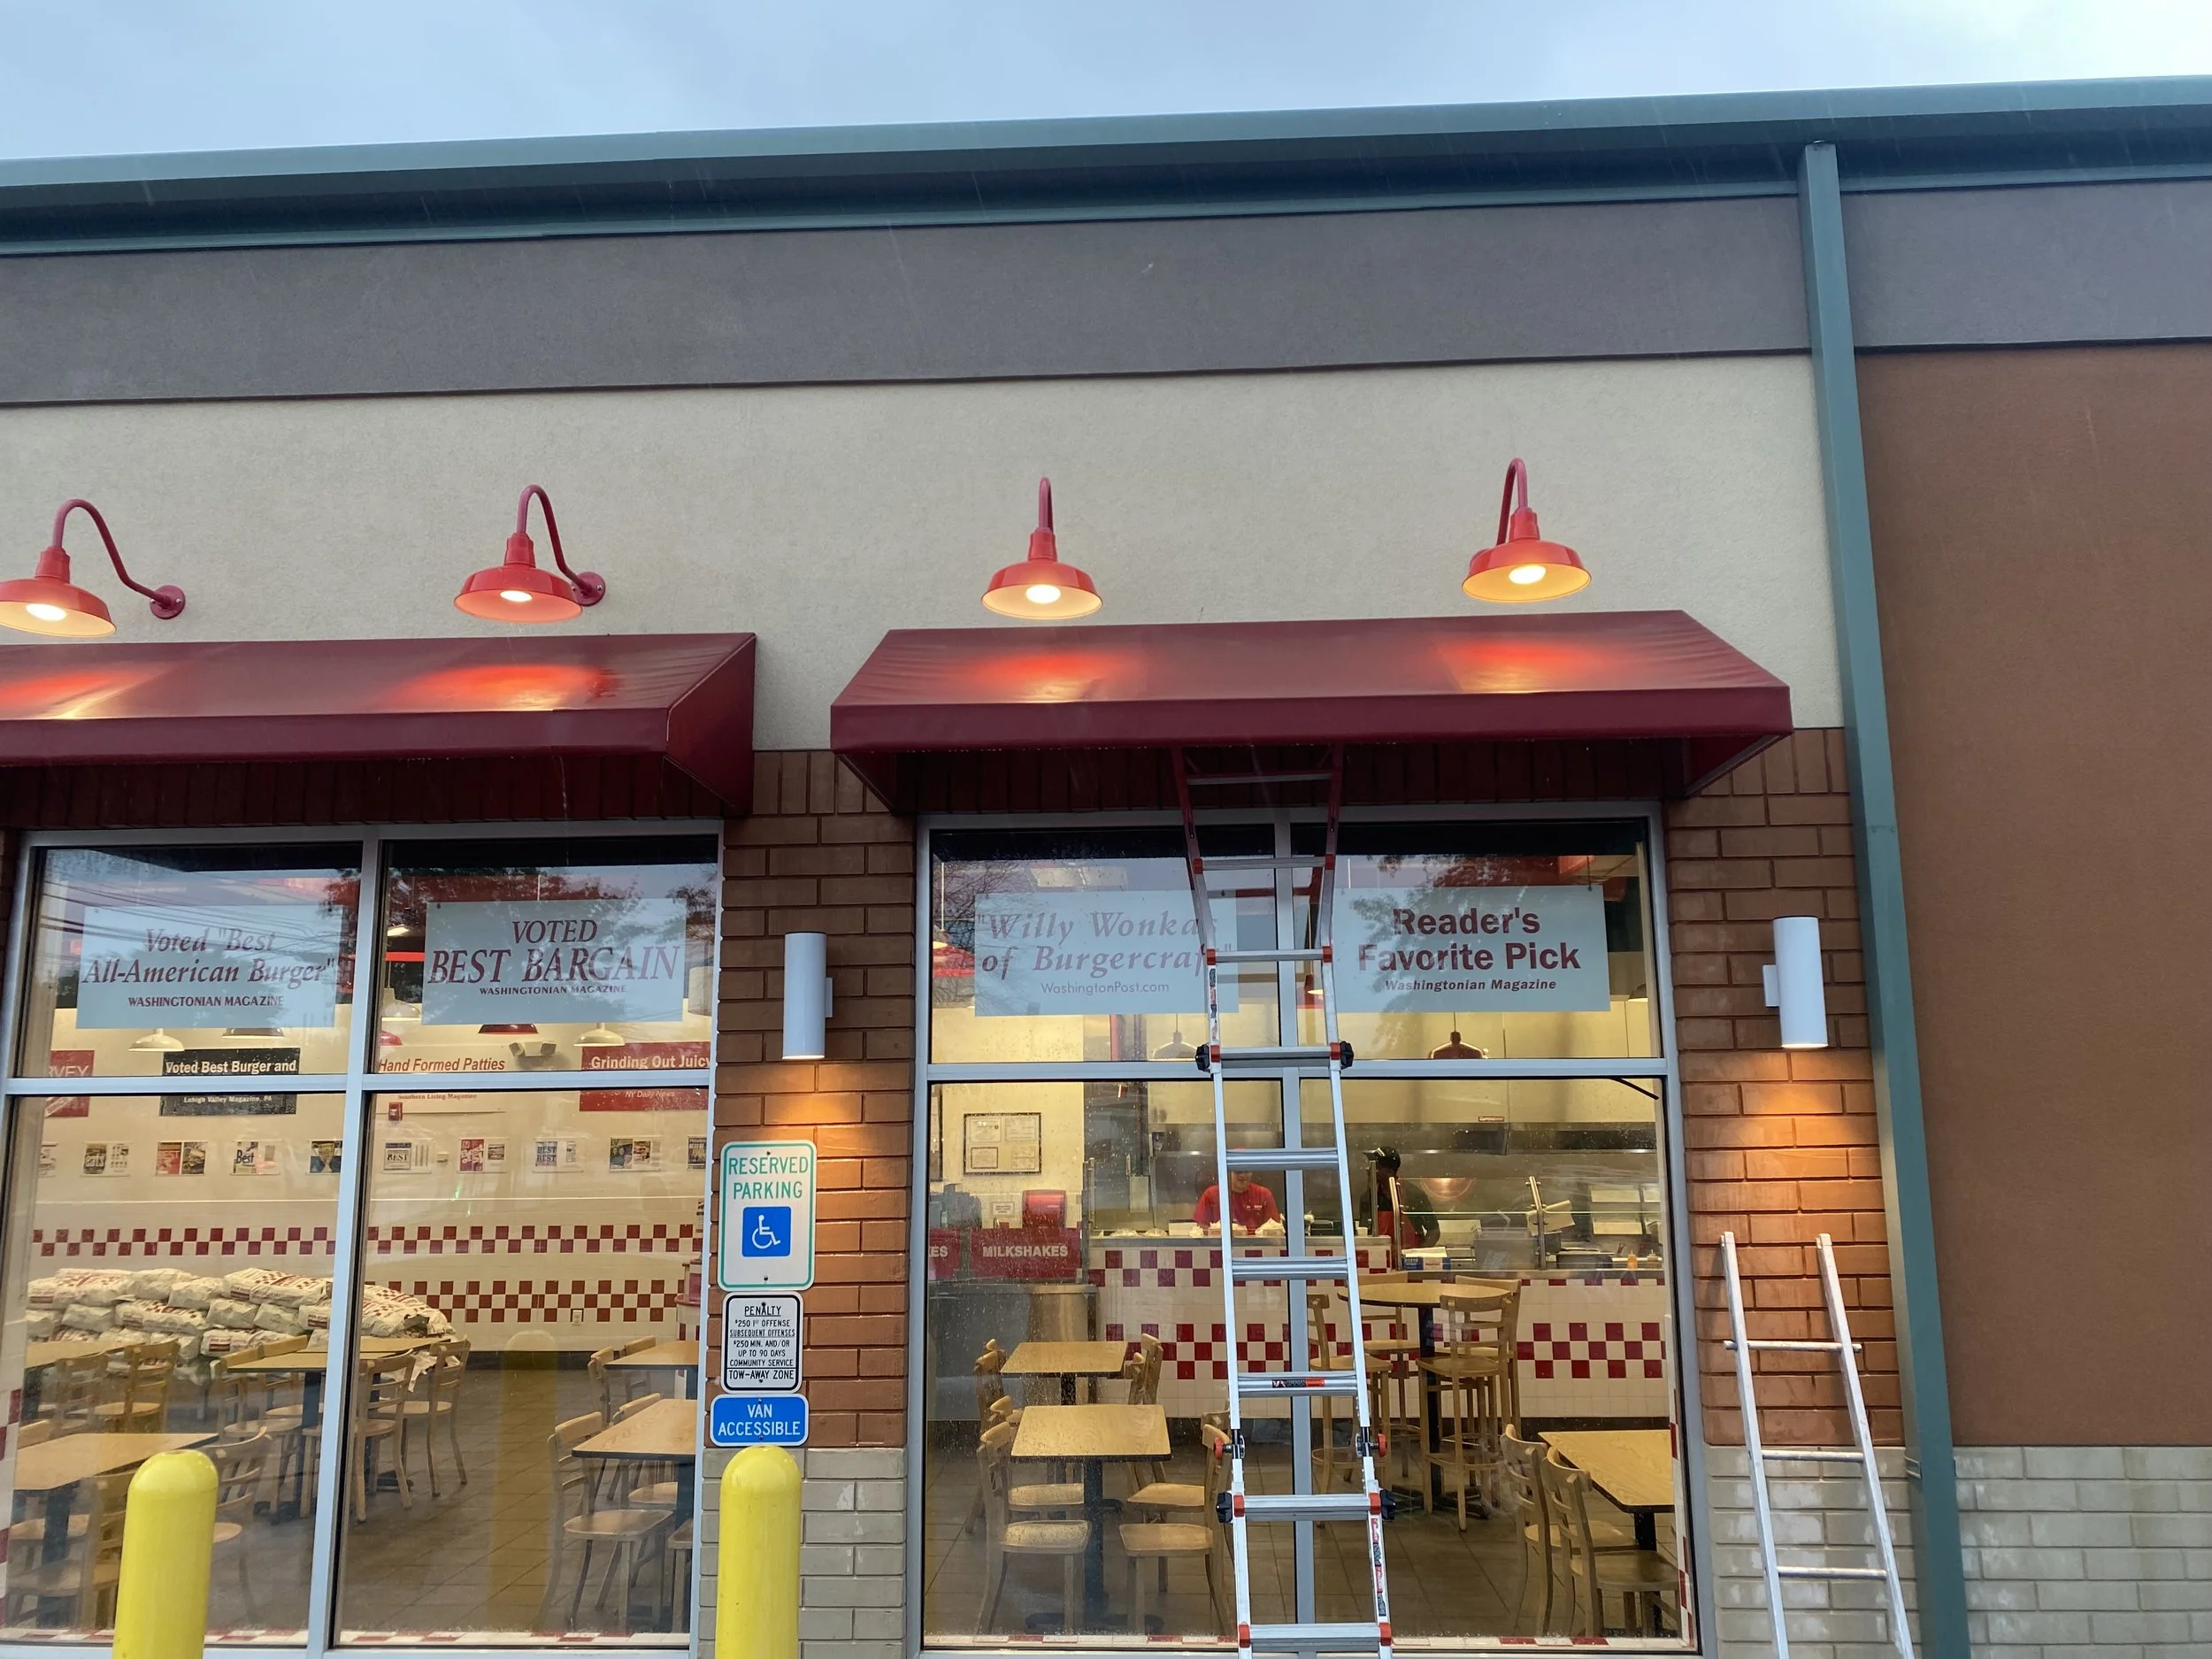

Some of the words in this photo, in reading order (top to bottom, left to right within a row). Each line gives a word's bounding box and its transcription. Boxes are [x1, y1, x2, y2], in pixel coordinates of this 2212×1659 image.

[978, 911, 1074, 945] "Willy
[1089, 910, 1217, 938] Wonka
[1393, 907, 1540, 935] Reader's
[511, 919, 598, 944] VOTED
[146, 928, 209, 953] Voted
[218, 927, 276, 952] "Best
[981, 946, 1018, 980] of
[1033, 944, 1233, 979] Burgercraf"
[1358, 942, 1494, 972] Favorite
[1505, 941, 1582, 970] Pick
[428, 949, 511, 984] BEST
[522, 945, 681, 982] BARGAIN
[82, 958, 240, 984] All-American
[248, 957, 337, 989] Burger"
[480, 985, 567, 995] WASHINGTONIAN
[571, 984, 627, 995] MAGAZINE
[1041, 981, 1170, 996] WashingtonPost.com
[1386, 979, 1486, 993] Washingtonian
[1491, 979, 1557, 991] Magazine
[127, 995, 221, 1008] WASHINGTONIAN
[225, 995, 284, 1007] MAGAZINE
[165, 1060, 198, 1074] Voted
[201, 1060, 228, 1073] Best
[231, 1060, 272, 1075] Burger
[274, 1059, 296, 1072] and
[379, 1058, 411, 1072] Hand
[412, 1058, 460, 1071] Formed
[463, 1057, 505, 1071] Patties
[591, 1056, 649, 1069] Grinding
[652, 1055, 675, 1068] Out
[208, 1095, 227, 1104] Valley
[637, 1090, 653, 1099] Daily
[235, 1149, 254, 1164] Best
[728, 1156, 809, 1175] RESERVED
[733, 1181, 803, 1200] PARKING
[983, 1246, 1069, 1258] MILKSHAKES
[744, 1305, 781, 1316] PENALTY
[730, 1329, 765, 1338] SUBSEQUENT
[729, 1370, 770, 1379] TOW-AWAY
[773, 1370, 794, 1379] ZONE
[747, 1403, 772, 1418] VAN
[718, 1420, 800, 1437] ACCESSIBLE
